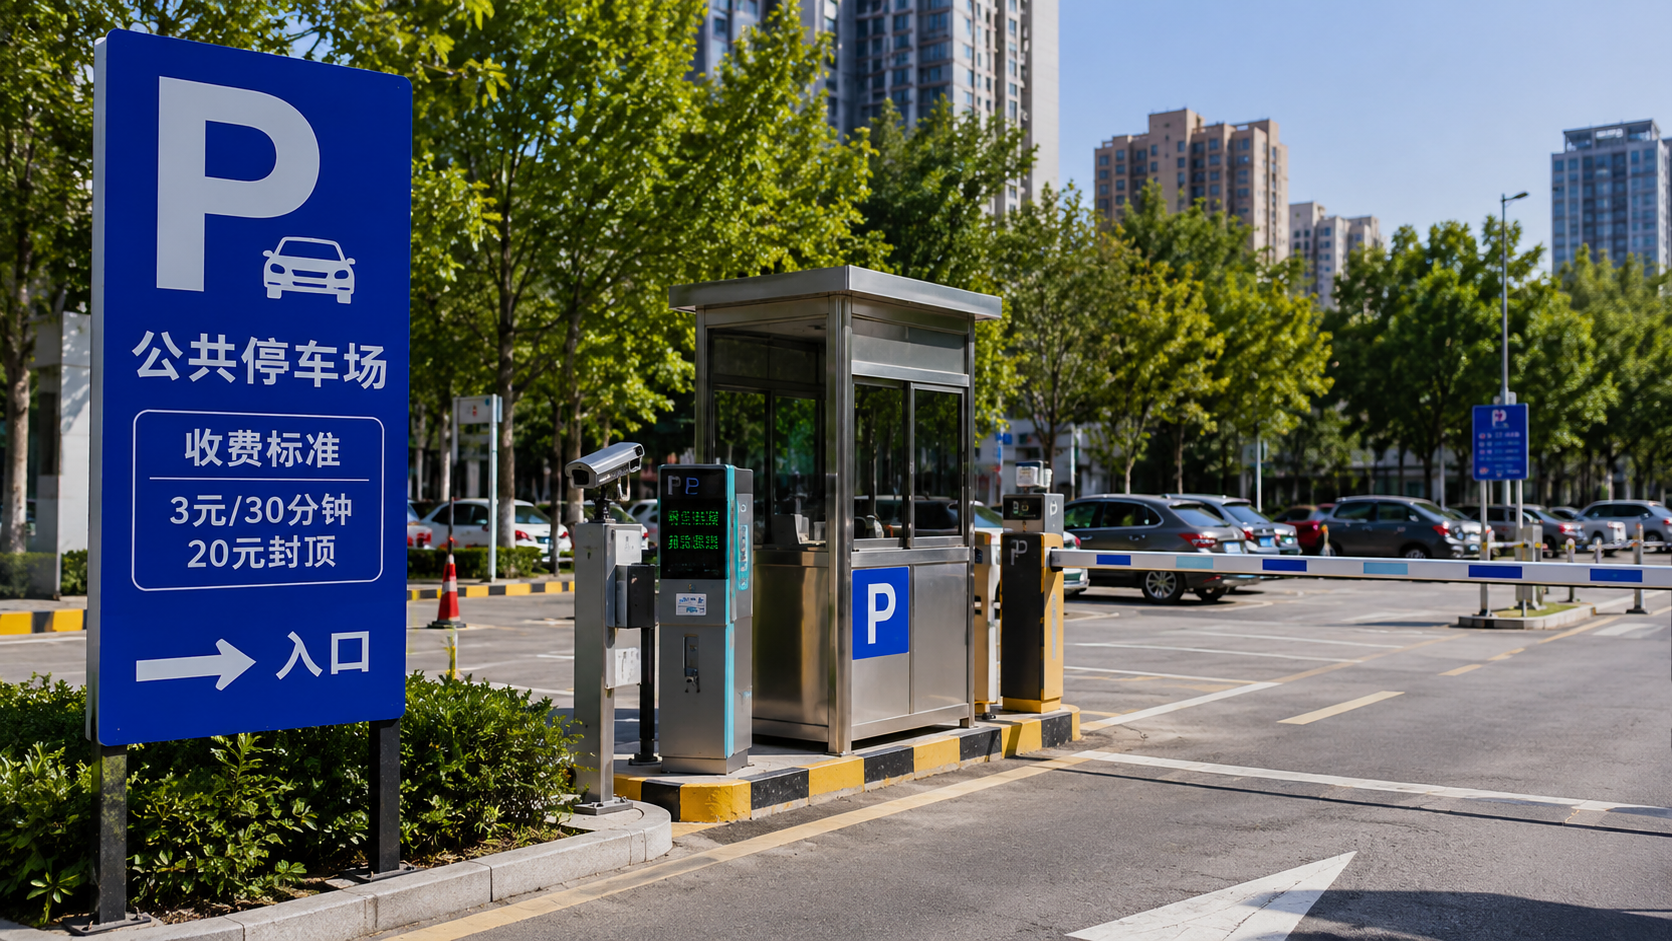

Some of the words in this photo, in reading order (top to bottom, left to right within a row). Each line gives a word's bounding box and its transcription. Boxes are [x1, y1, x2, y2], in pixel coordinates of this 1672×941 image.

[157, 76, 320, 291] P
[132, 331, 387, 390] 公共停车场
[185, 428, 341, 468] 收费标准
[170, 493, 352, 527] 3元/30分钟
[187, 535, 336, 570] 20元封顶
[868, 583, 896, 645] P
[275, 631, 370, 680] 入口
